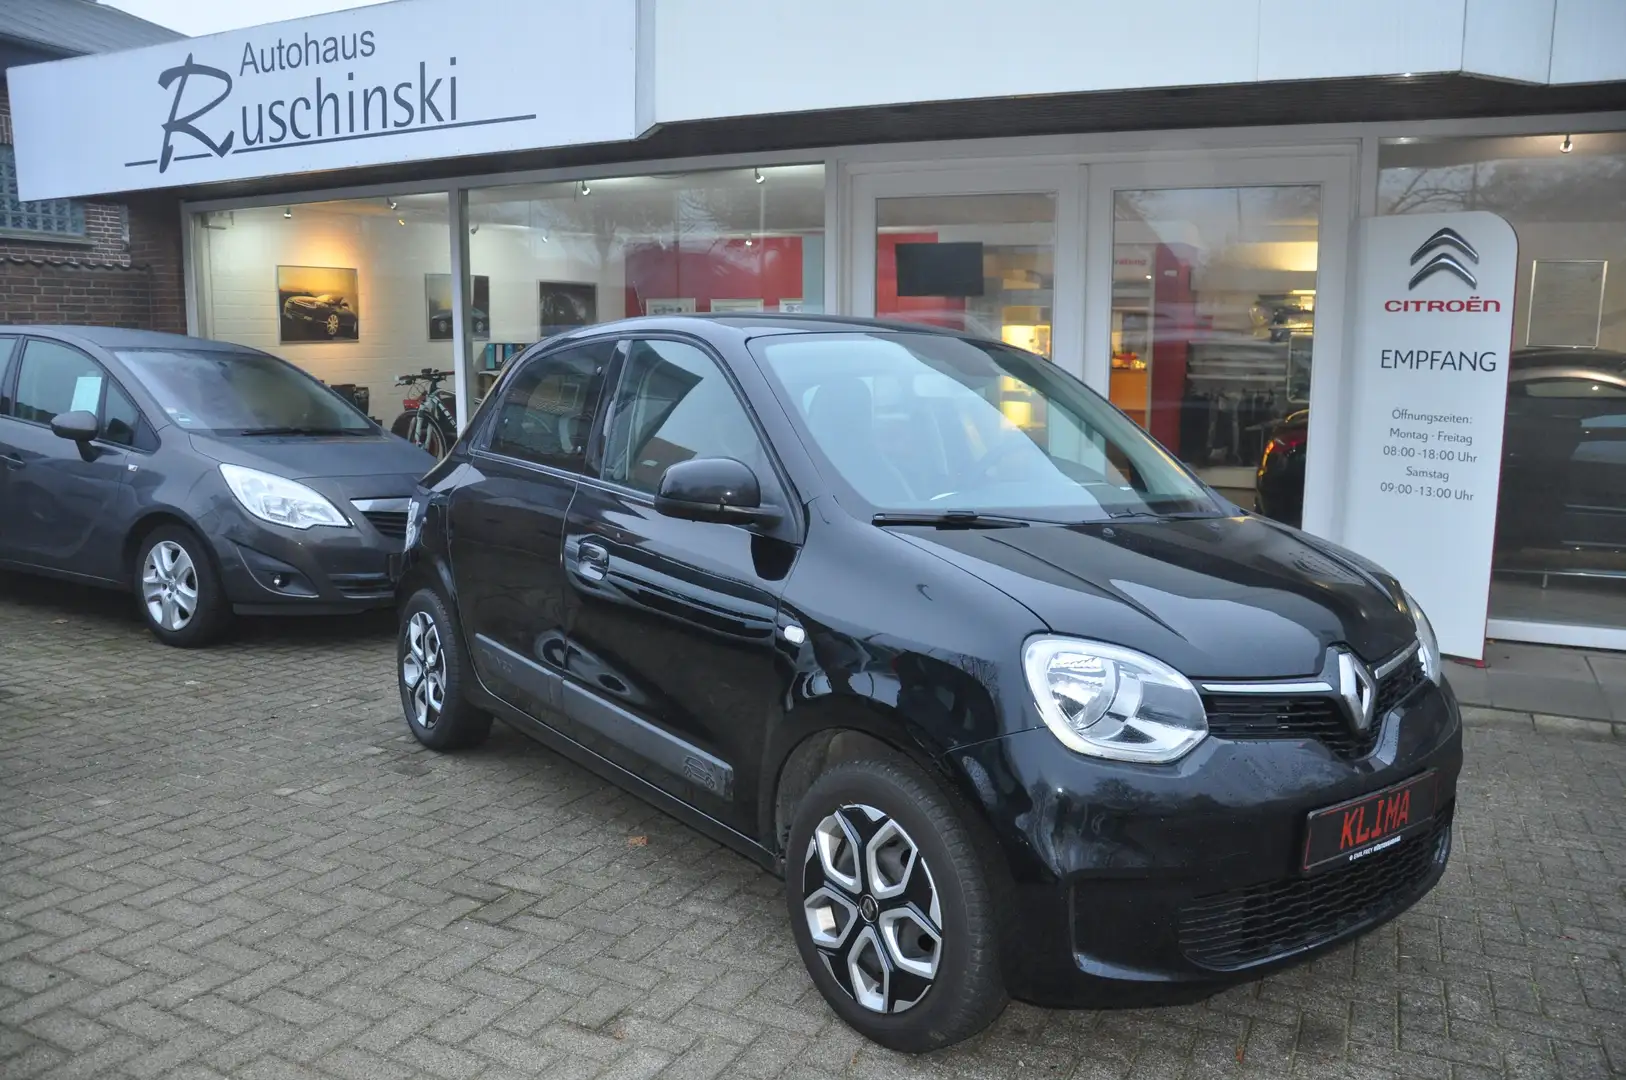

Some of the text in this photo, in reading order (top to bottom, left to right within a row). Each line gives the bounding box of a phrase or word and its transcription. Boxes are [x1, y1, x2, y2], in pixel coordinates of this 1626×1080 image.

[239, 30, 376, 76] Autohaus
[158, 52, 457, 174] Ruschinski
[1381, 349, 1496, 372] EMPFANG
[1392, 407, 1473, 425] Öffnungszeiten:
[1389, 427, 1428, 443] Montag
[1437, 430, 1473, 446] Freitag
[1383, 445, 1416, 458] 08:00
[1457, 452, 1478, 463] Uhr
[1406, 466, 1449, 483] Samstag
[1380, 482, 1413, 495] 09:00
[1454, 489, 1474, 501] Uhr
[1340, 789, 1410, 849] KLIMA
